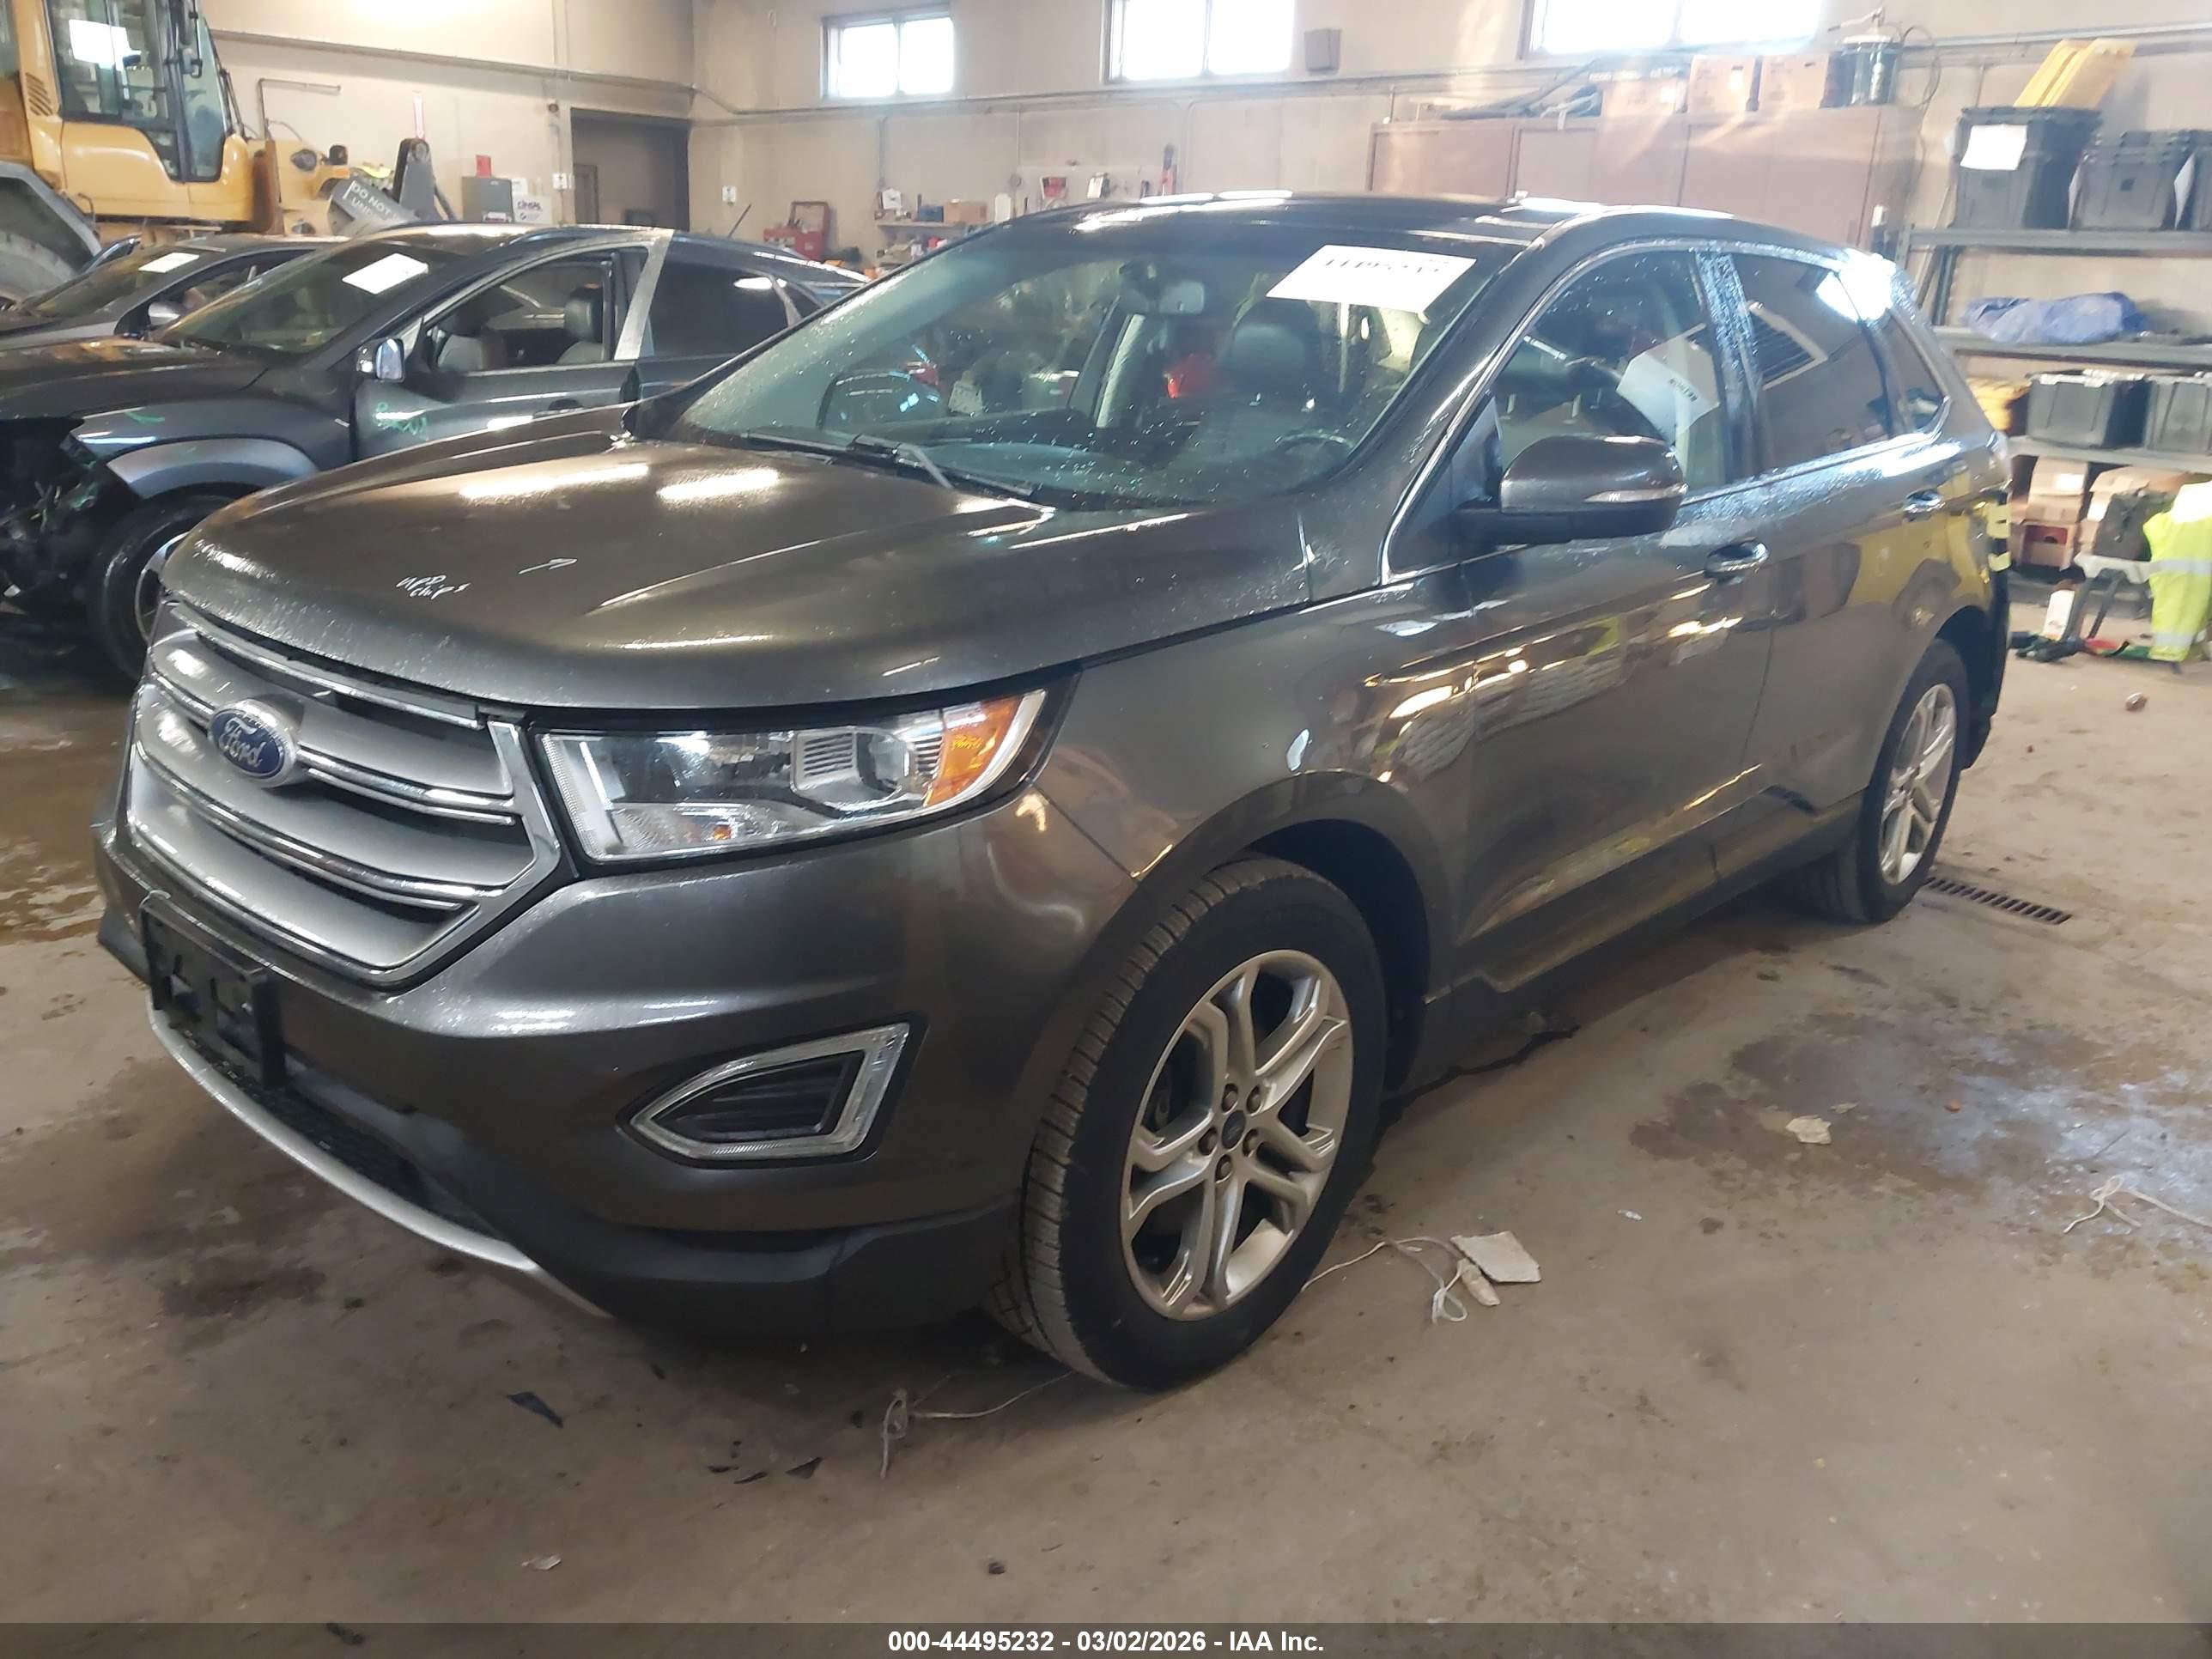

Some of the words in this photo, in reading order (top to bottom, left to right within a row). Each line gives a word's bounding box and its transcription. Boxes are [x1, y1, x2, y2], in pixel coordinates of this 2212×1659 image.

[350, 182, 368, 198] DO
[368, 196, 392, 216] NOT
[218, 716, 266, 768] Ford
